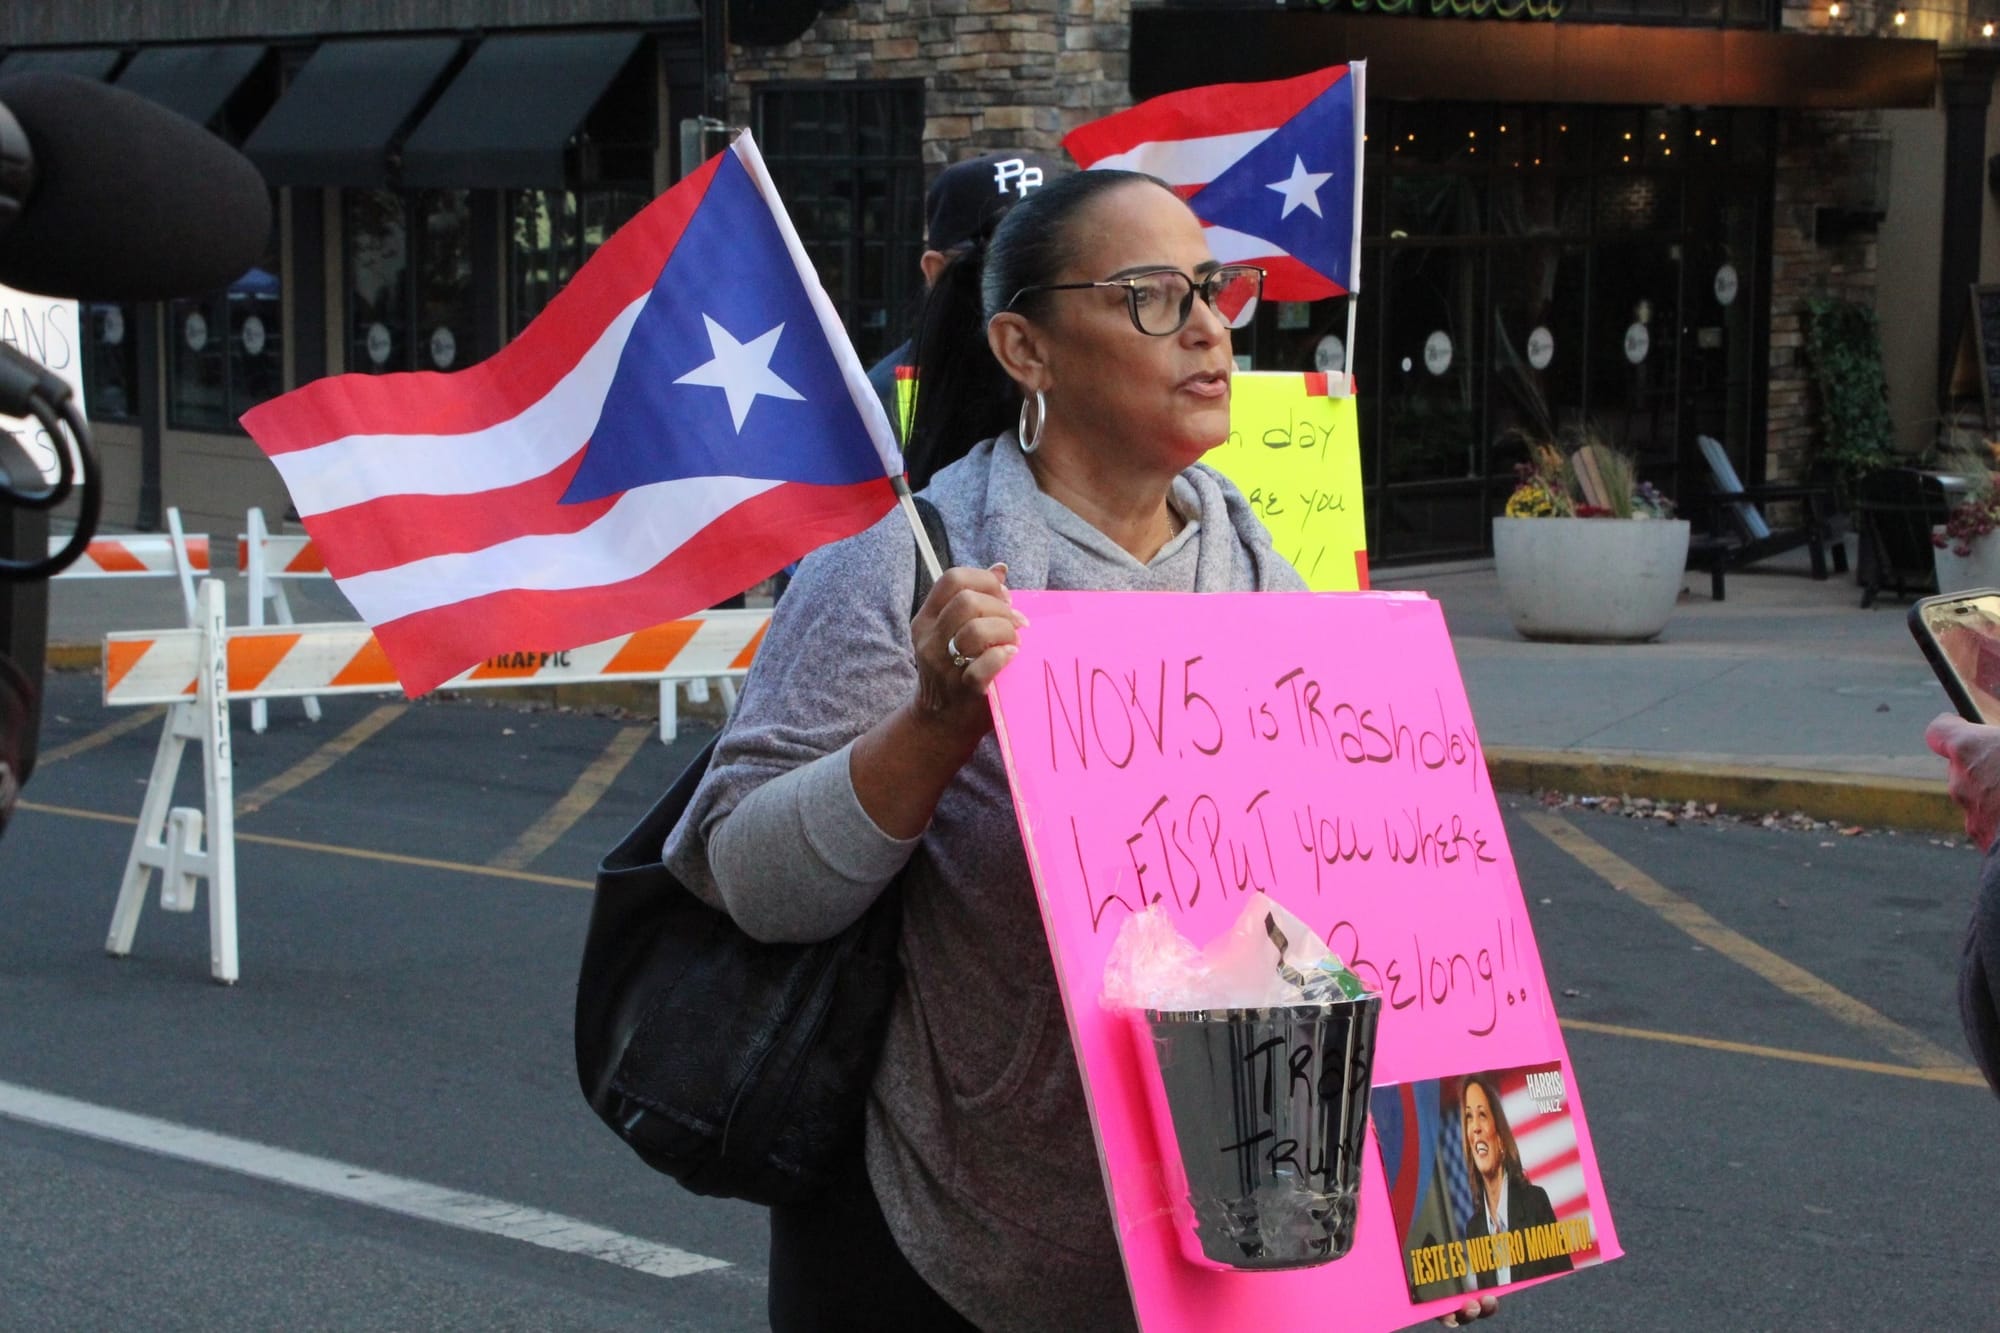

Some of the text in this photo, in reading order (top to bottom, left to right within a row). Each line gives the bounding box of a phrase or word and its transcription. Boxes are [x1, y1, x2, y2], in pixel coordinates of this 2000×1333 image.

[1262, 407, 1336, 461] day
[214, 615, 229, 761] TAFFIC
[1245, 687, 1279, 741] is
[1526, 1070, 1563, 1099] HARRIS
[1537, 1099, 1562, 1114] WALZ
[1411, 1216, 1593, 1286] ¡ESTE ES NUESTRO MOMENTO!
